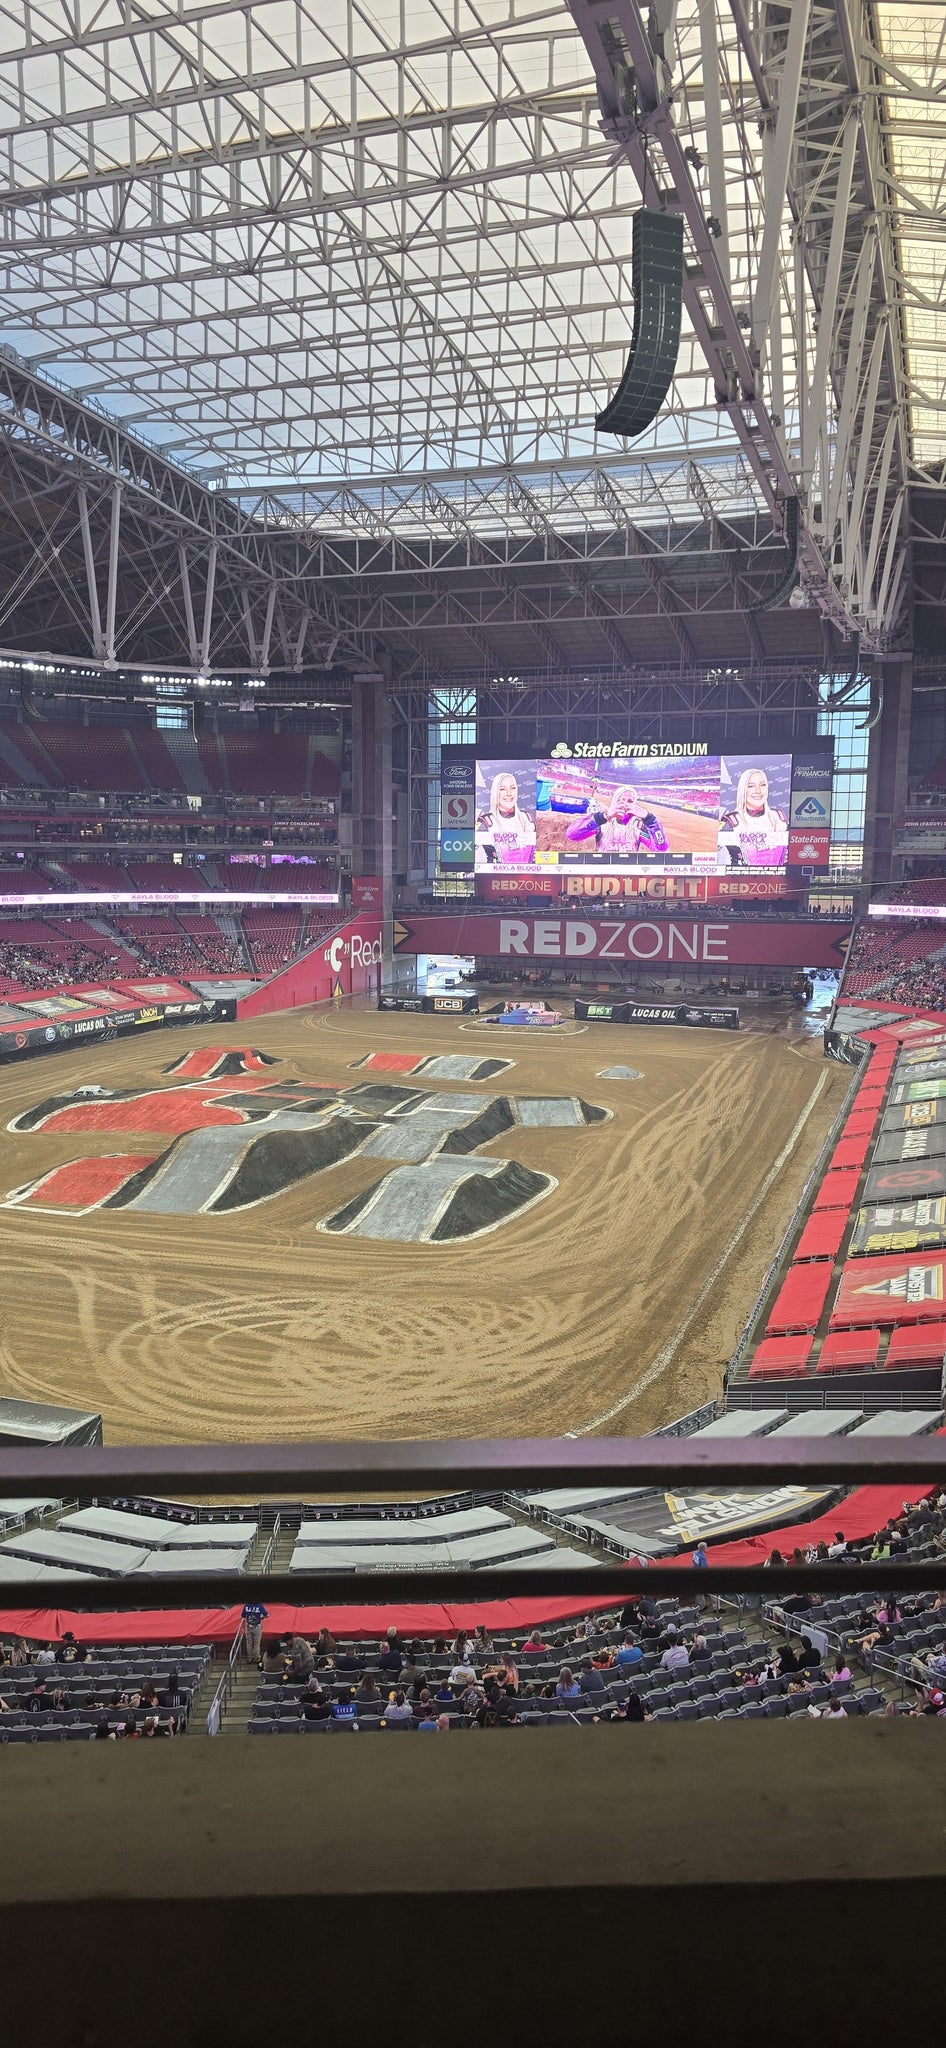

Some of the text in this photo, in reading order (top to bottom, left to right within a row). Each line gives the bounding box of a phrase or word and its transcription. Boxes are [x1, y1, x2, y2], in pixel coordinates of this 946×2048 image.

[650, 743, 708, 756] STADIUM
[443, 841, 472, 851] COX
[492, 880, 551, 891] REDZONE
[567, 877, 702, 898] BUD LIGHT
[719, 882, 788, 894] REDZONE
[500, 920, 729, 960] REDZONE
[350, 932, 382, 969] Red
[437, 1000, 460, 1008] JCB
[632, 1009, 660, 1018] LUCAS
[662, 1010, 676, 1019] OIL
[74, 1020, 94, 1034] LUCAS
[95, 1019, 105, 1030] OIL
[915, 1199, 932, 1226] MONSTER
[889, 1279, 907, 1295] JAM
[907, 1266, 926, 1302] MONSTER
[655, 1485, 808, 1536] MONSTER
[676, 1493, 743, 1520] JAM
